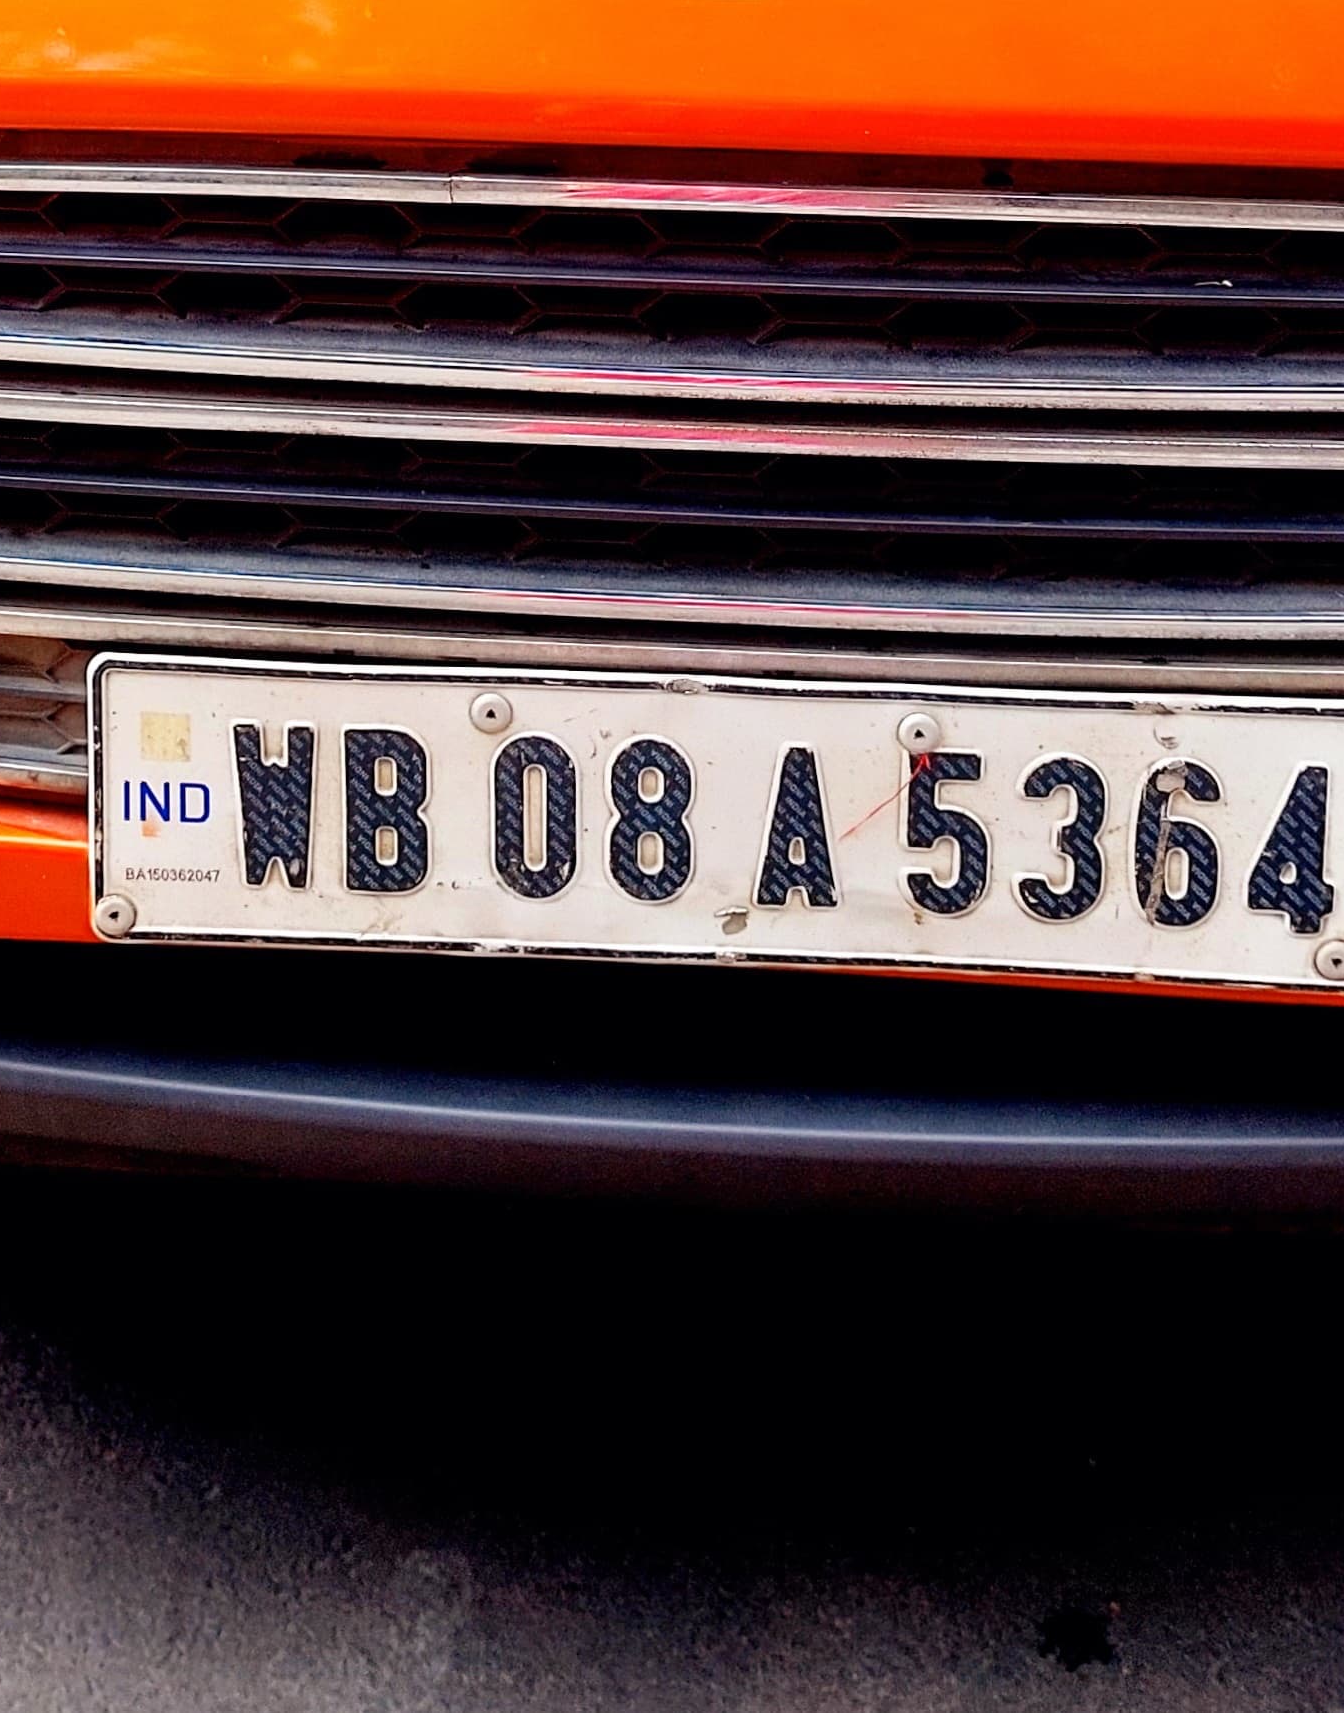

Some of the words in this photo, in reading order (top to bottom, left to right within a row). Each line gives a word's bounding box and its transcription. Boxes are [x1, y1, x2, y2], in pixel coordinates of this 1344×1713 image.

[123, 780, 210, 823] IND
[231, 723, 429, 893] WB
[493, 735, 693, 902] 08
[756, 746, 839, 908] A
[906, 752, 1336, 935] 5364
[125, 867, 220, 883] BA150362047
